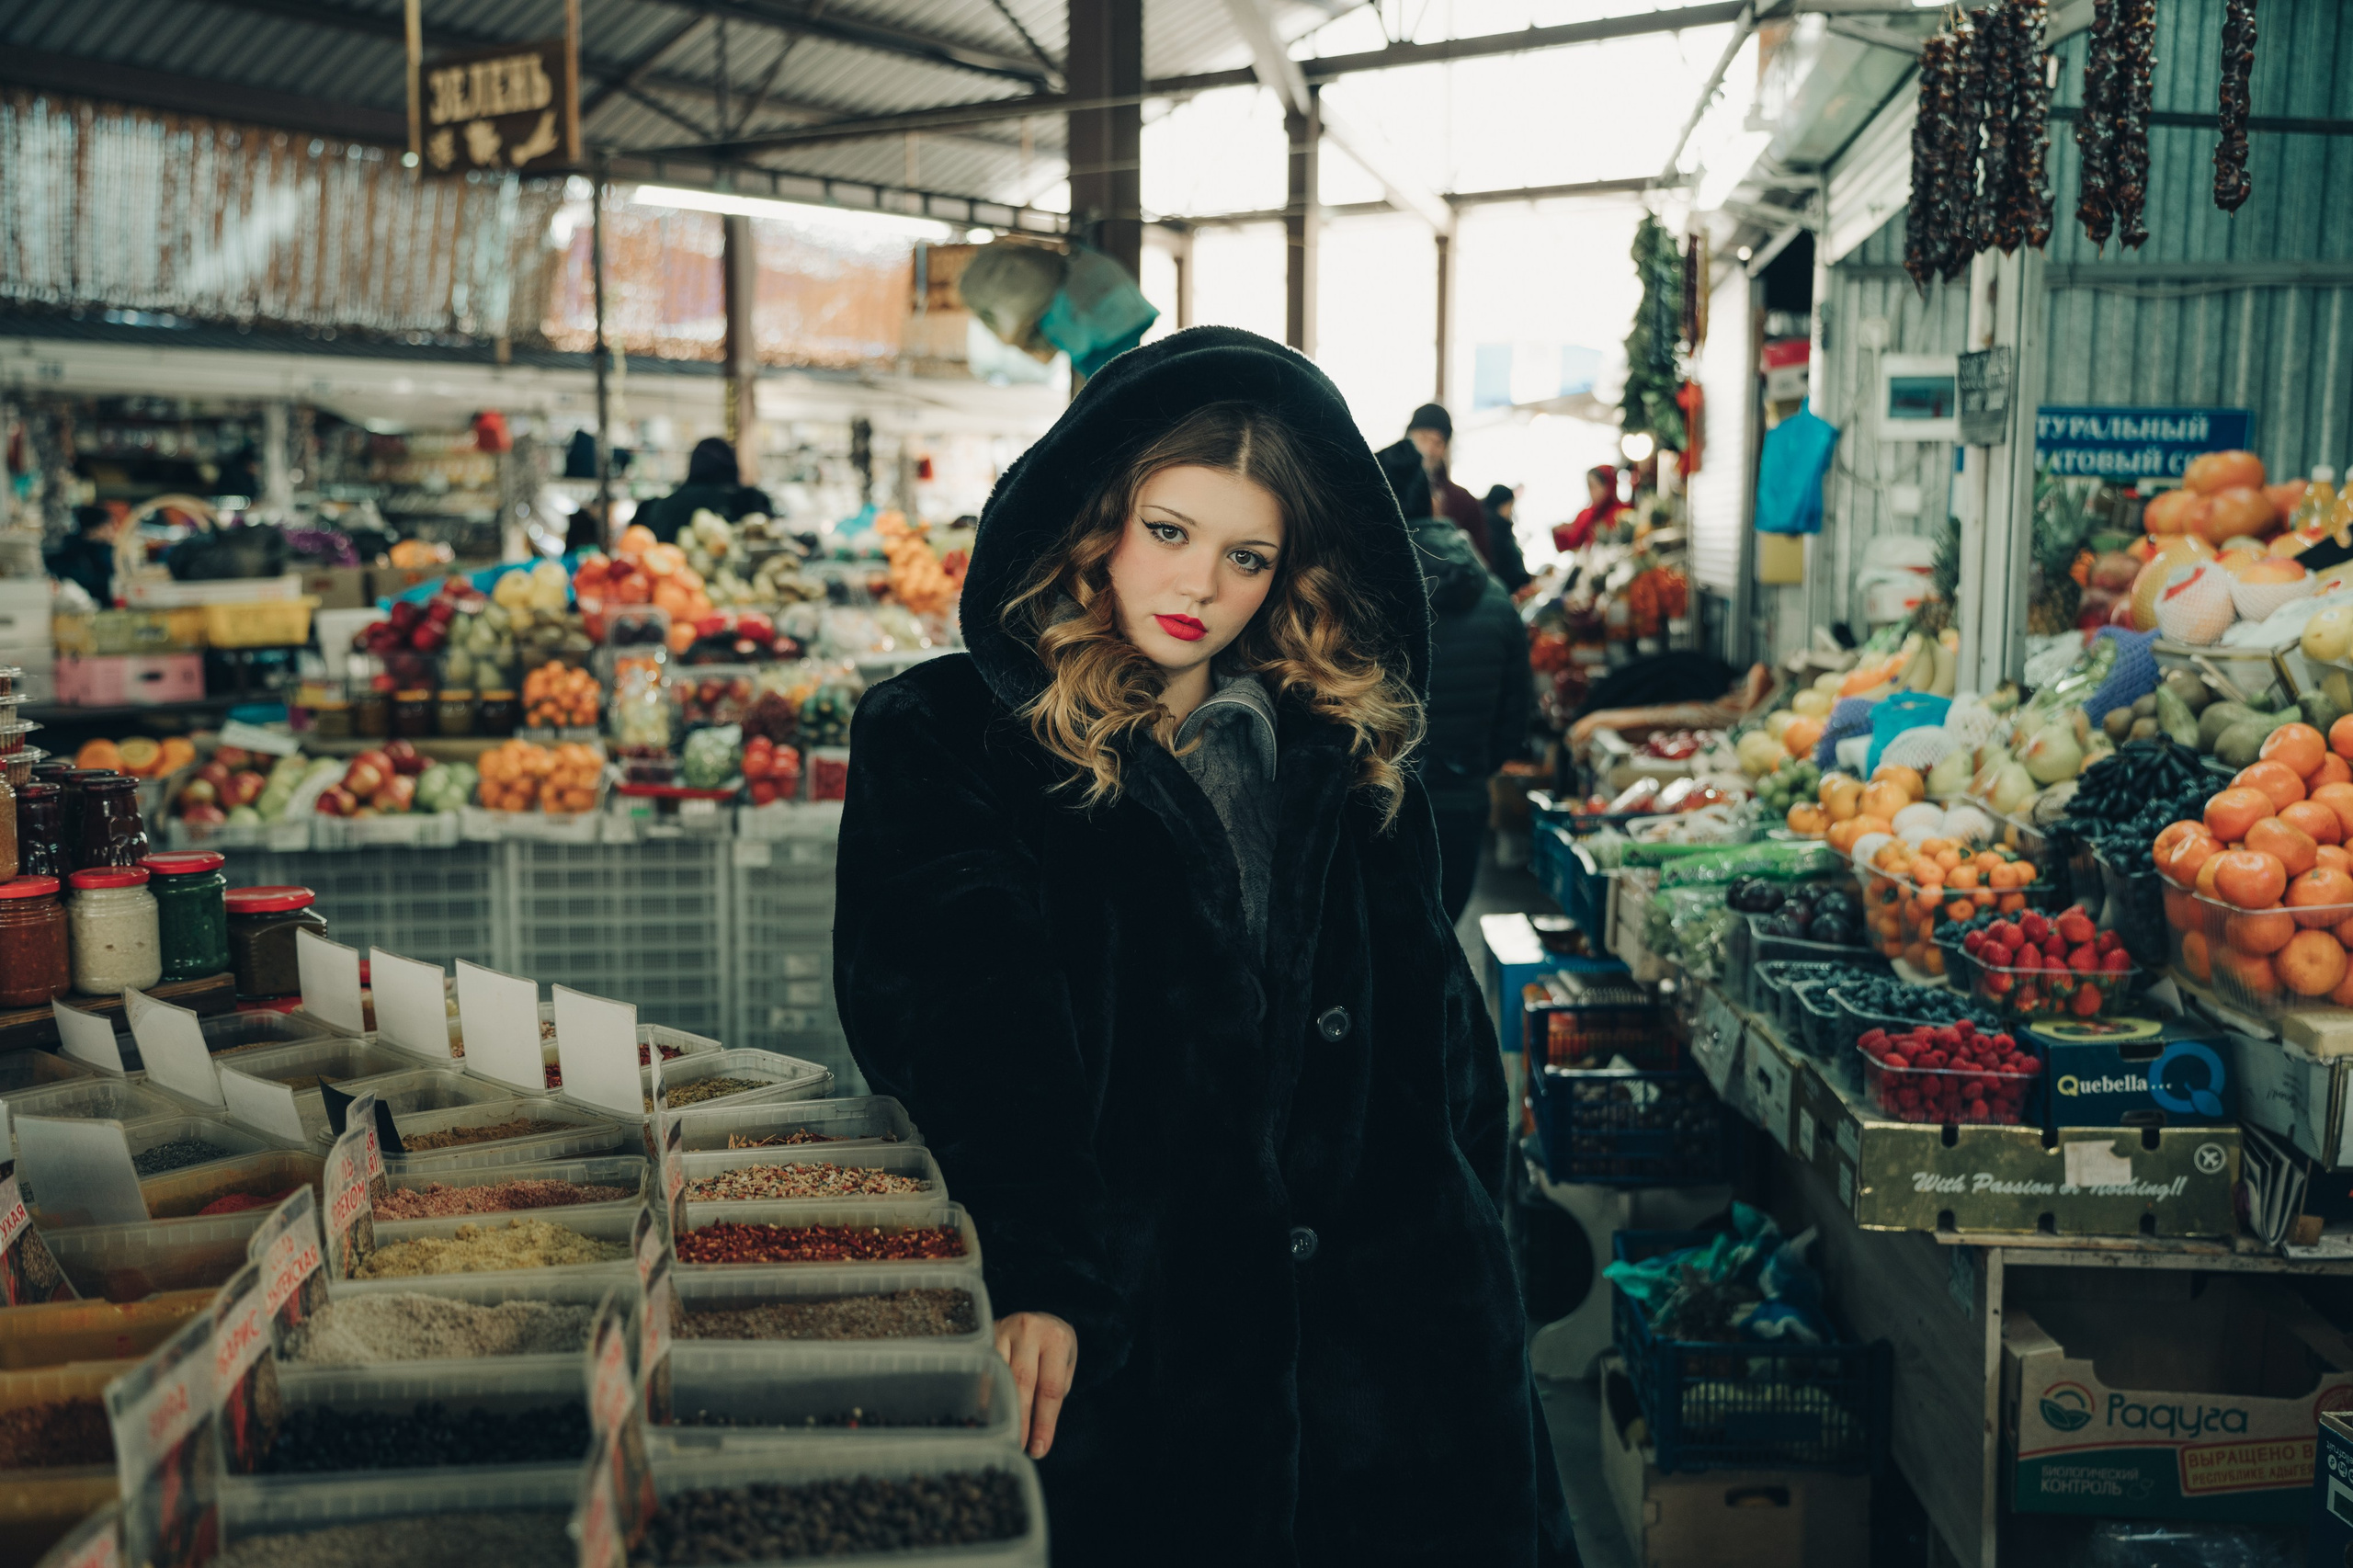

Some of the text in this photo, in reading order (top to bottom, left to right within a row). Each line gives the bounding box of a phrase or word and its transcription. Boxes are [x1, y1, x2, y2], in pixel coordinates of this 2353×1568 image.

[429, 53, 551, 125] ЗЕЛЕНЬ
[1912, 1171, 1966, 1195] With
[1971, 1172, 2054, 1196] Passion
[2107, 1392, 2249, 1439] Радуга
[2188, 1443, 2314, 1469] ВЫРАЩЕНО В
[2041, 1465, 2140, 1482] БИОЛОГИЧЕСКИЙ
[2191, 1468, 2265, 1485] РЕСПУБЛИКЕ
[2040, 1478, 2122, 1496] КОНТРОЛЬ
